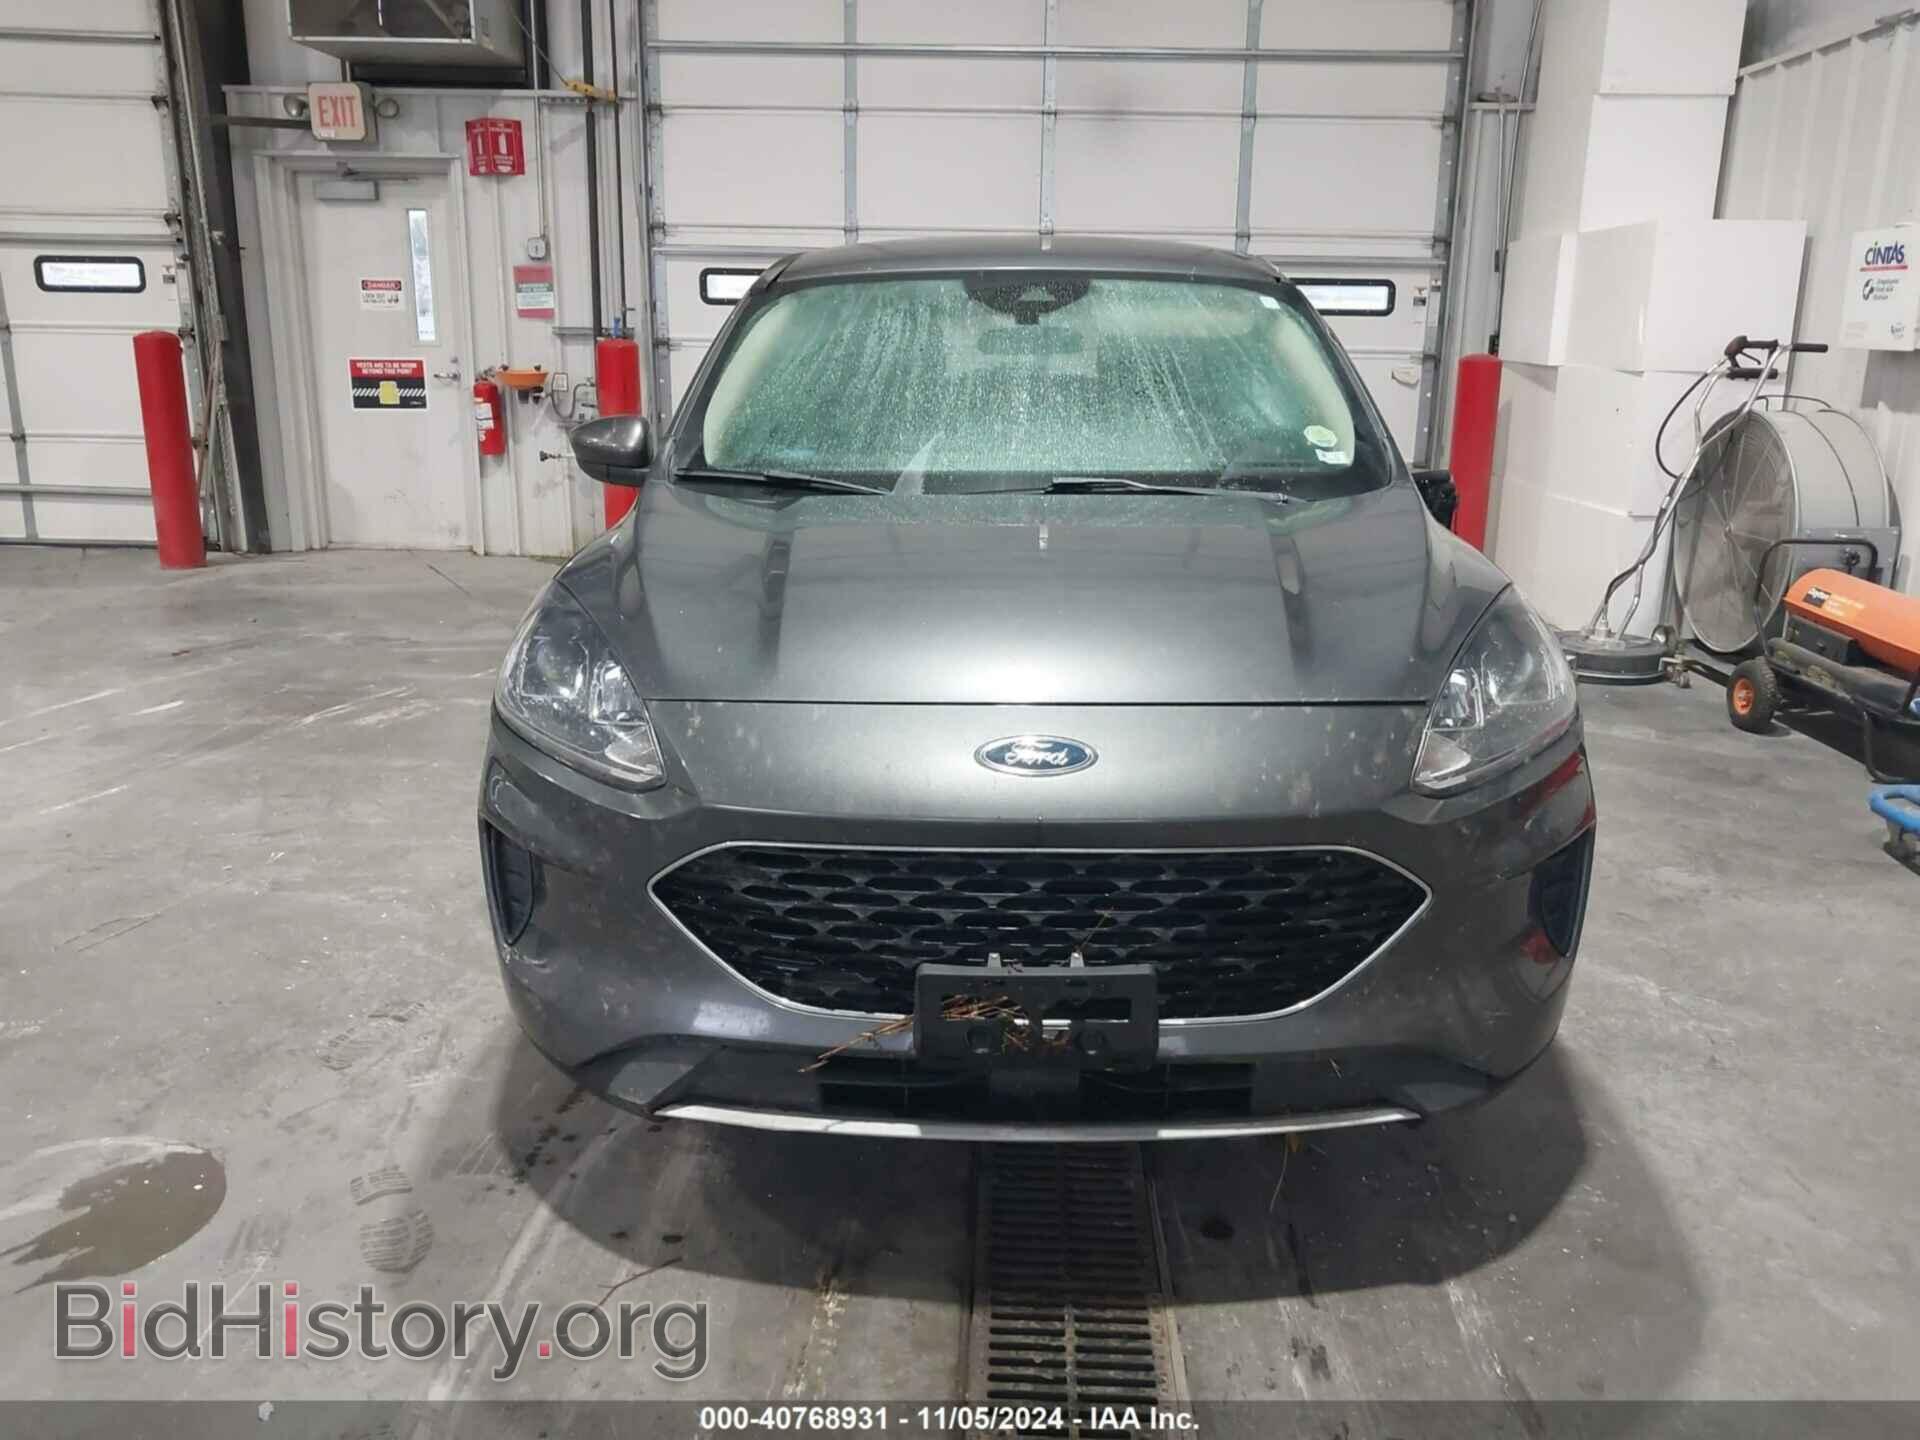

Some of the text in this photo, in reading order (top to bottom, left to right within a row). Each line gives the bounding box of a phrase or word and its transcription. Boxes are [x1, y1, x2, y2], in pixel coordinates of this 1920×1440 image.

[317, 96, 355, 128] EXIT
[366, 281, 396, 289] DANGER
[1004, 740, 1069, 766] Ford
